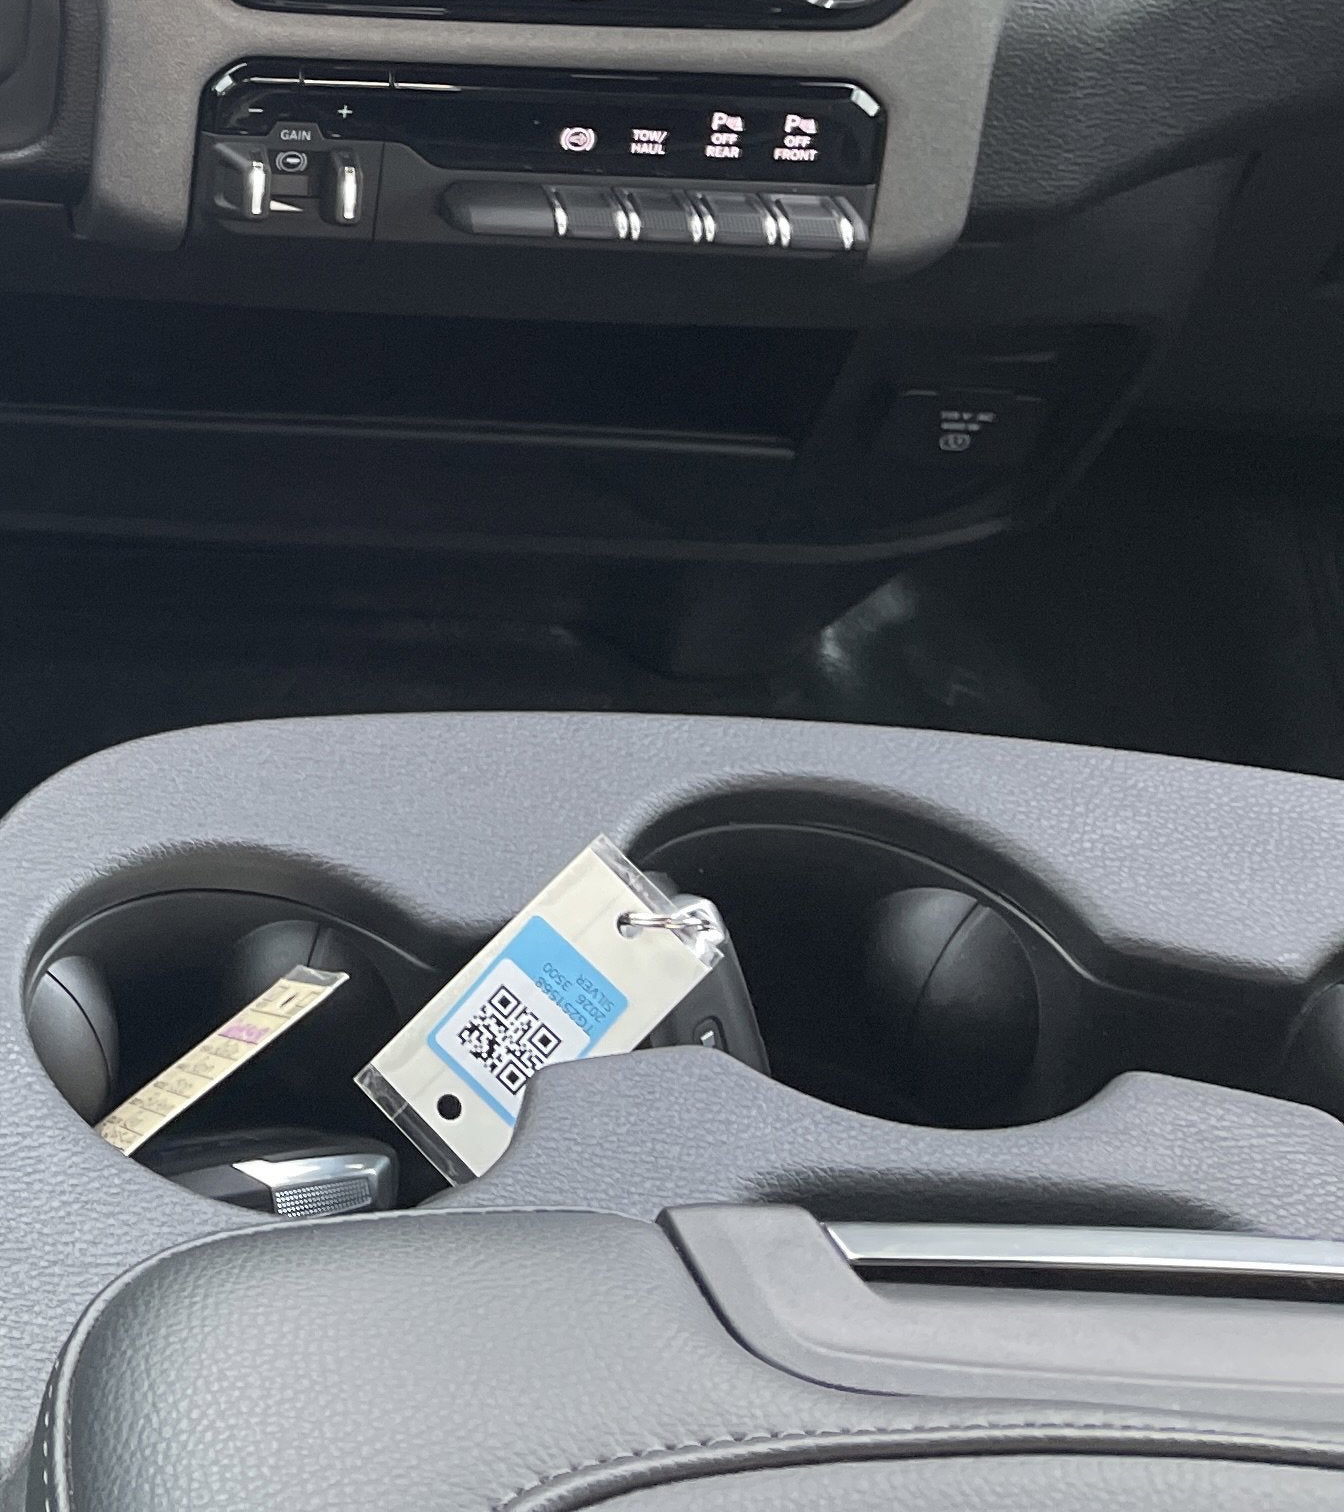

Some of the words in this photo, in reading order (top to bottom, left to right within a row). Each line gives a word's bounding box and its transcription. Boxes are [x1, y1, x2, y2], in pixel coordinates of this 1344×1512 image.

[280, 129, 312, 141] GAIN
[631, 128, 668, 144] TOW/
[710, 132, 739, 145] OFF
[783, 135, 812, 148] OFF
[630, 142, 666, 156] HAUL
[705, 144, 741, 158] REAR
[773, 147, 819, 161] FRONT
[575, 974, 615, 1013] SILVER
